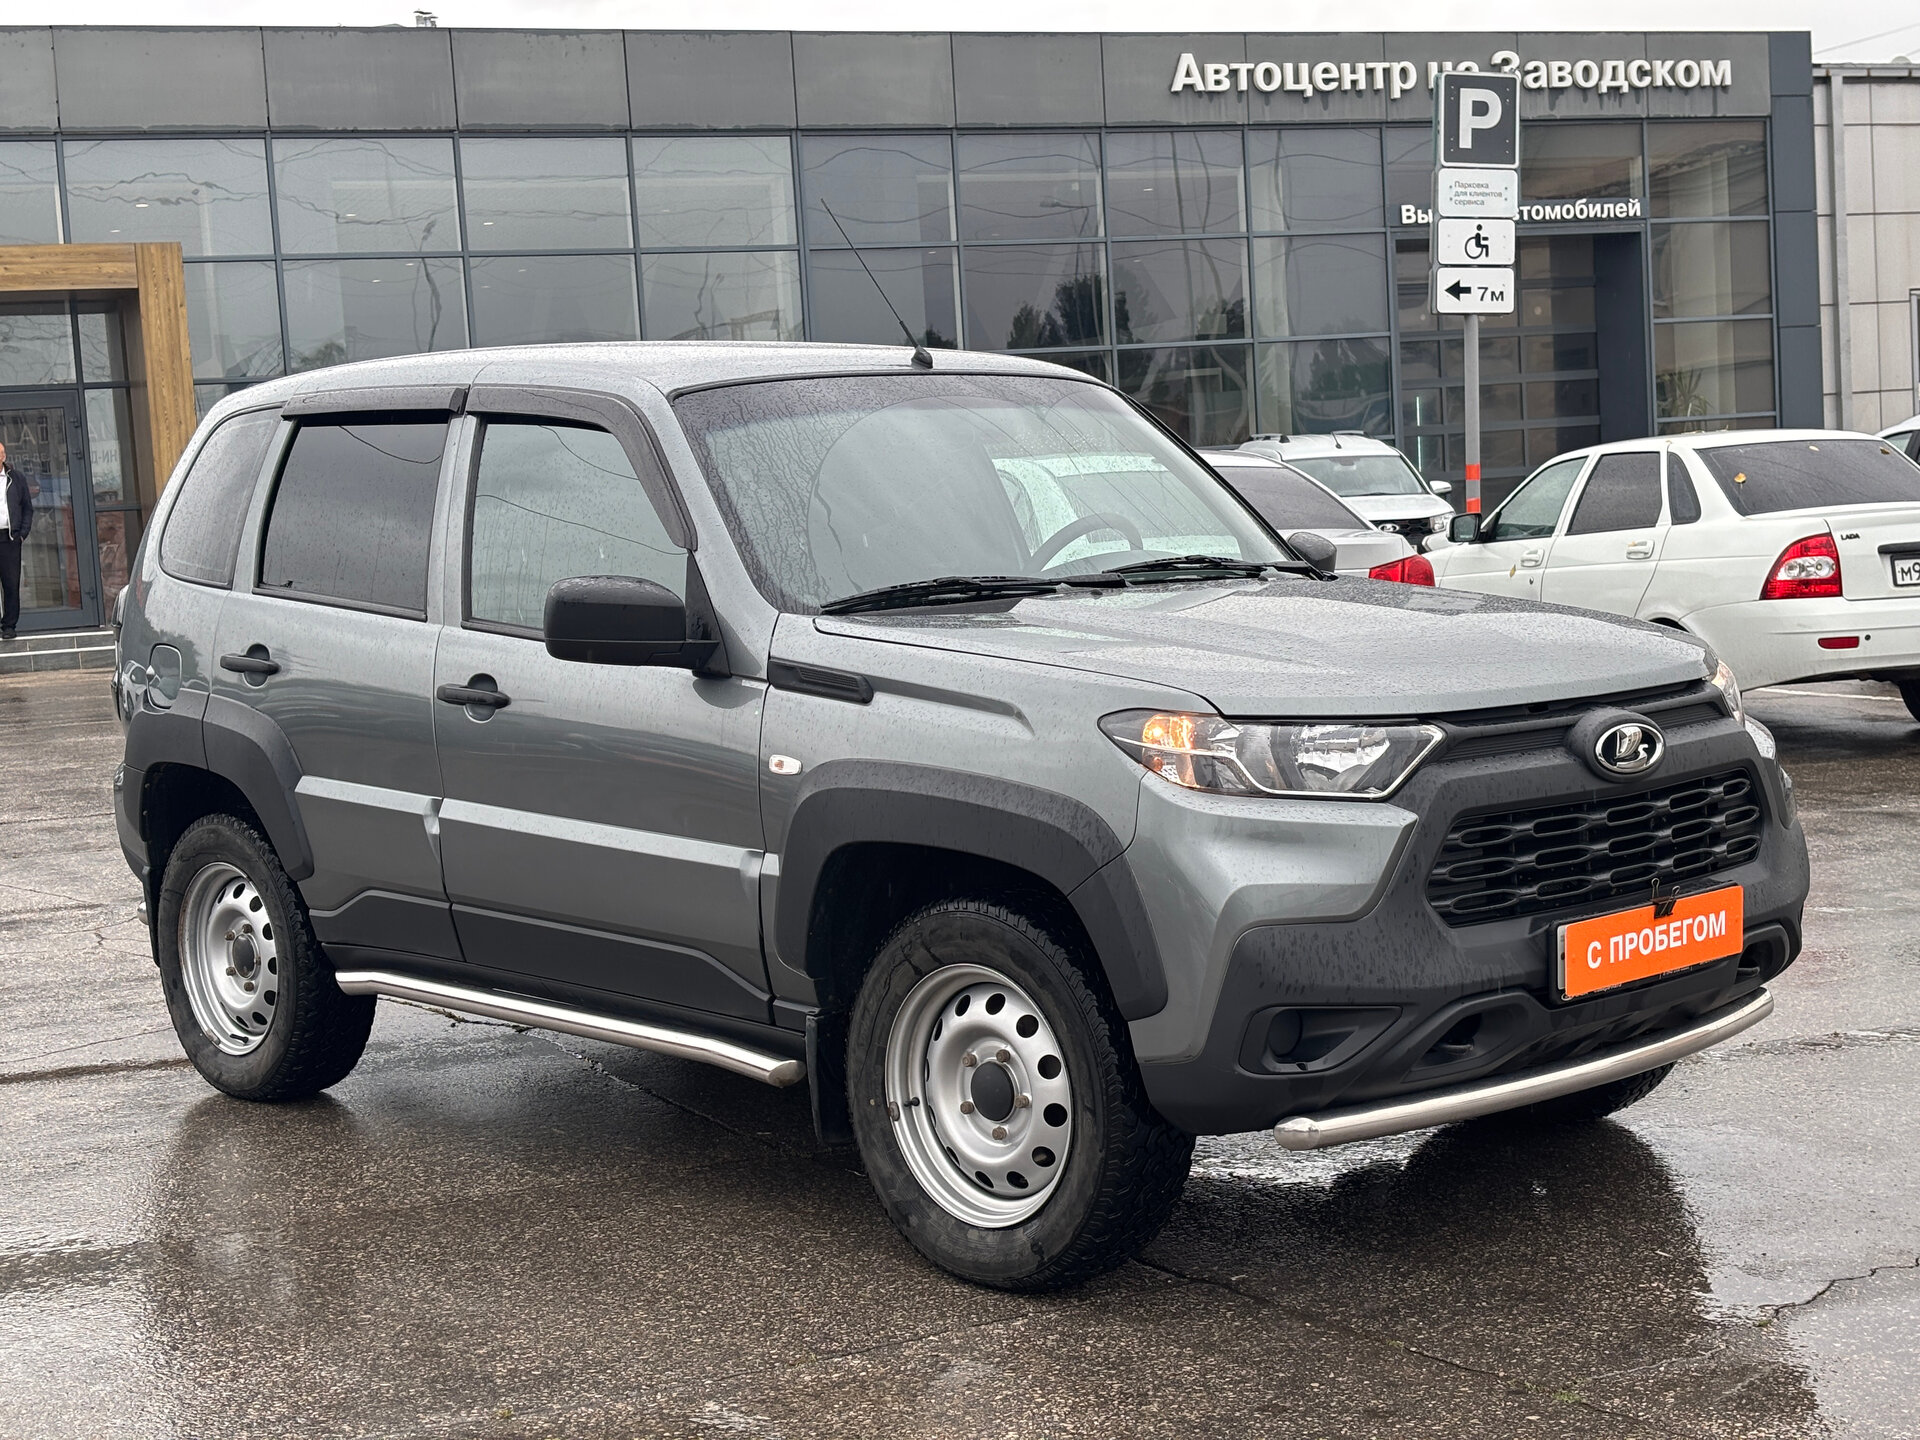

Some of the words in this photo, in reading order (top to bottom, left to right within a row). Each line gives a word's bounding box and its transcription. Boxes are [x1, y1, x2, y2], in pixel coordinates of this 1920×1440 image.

[1170, 52, 1418, 99] Автоцентр
[1454, 180, 1489, 190] Парковка
[1454, 190, 1468, 198] для
[1469, 190, 1503, 198] клиентов
[1454, 199, 1485, 207] сервиса
[1513, 198, 1642, 222] томобилей
[1840, 532, 1861, 541] LADA
[1587, 940, 1602, 970] С
[1609, 910, 1726, 964] ПРОБЕГОМ
